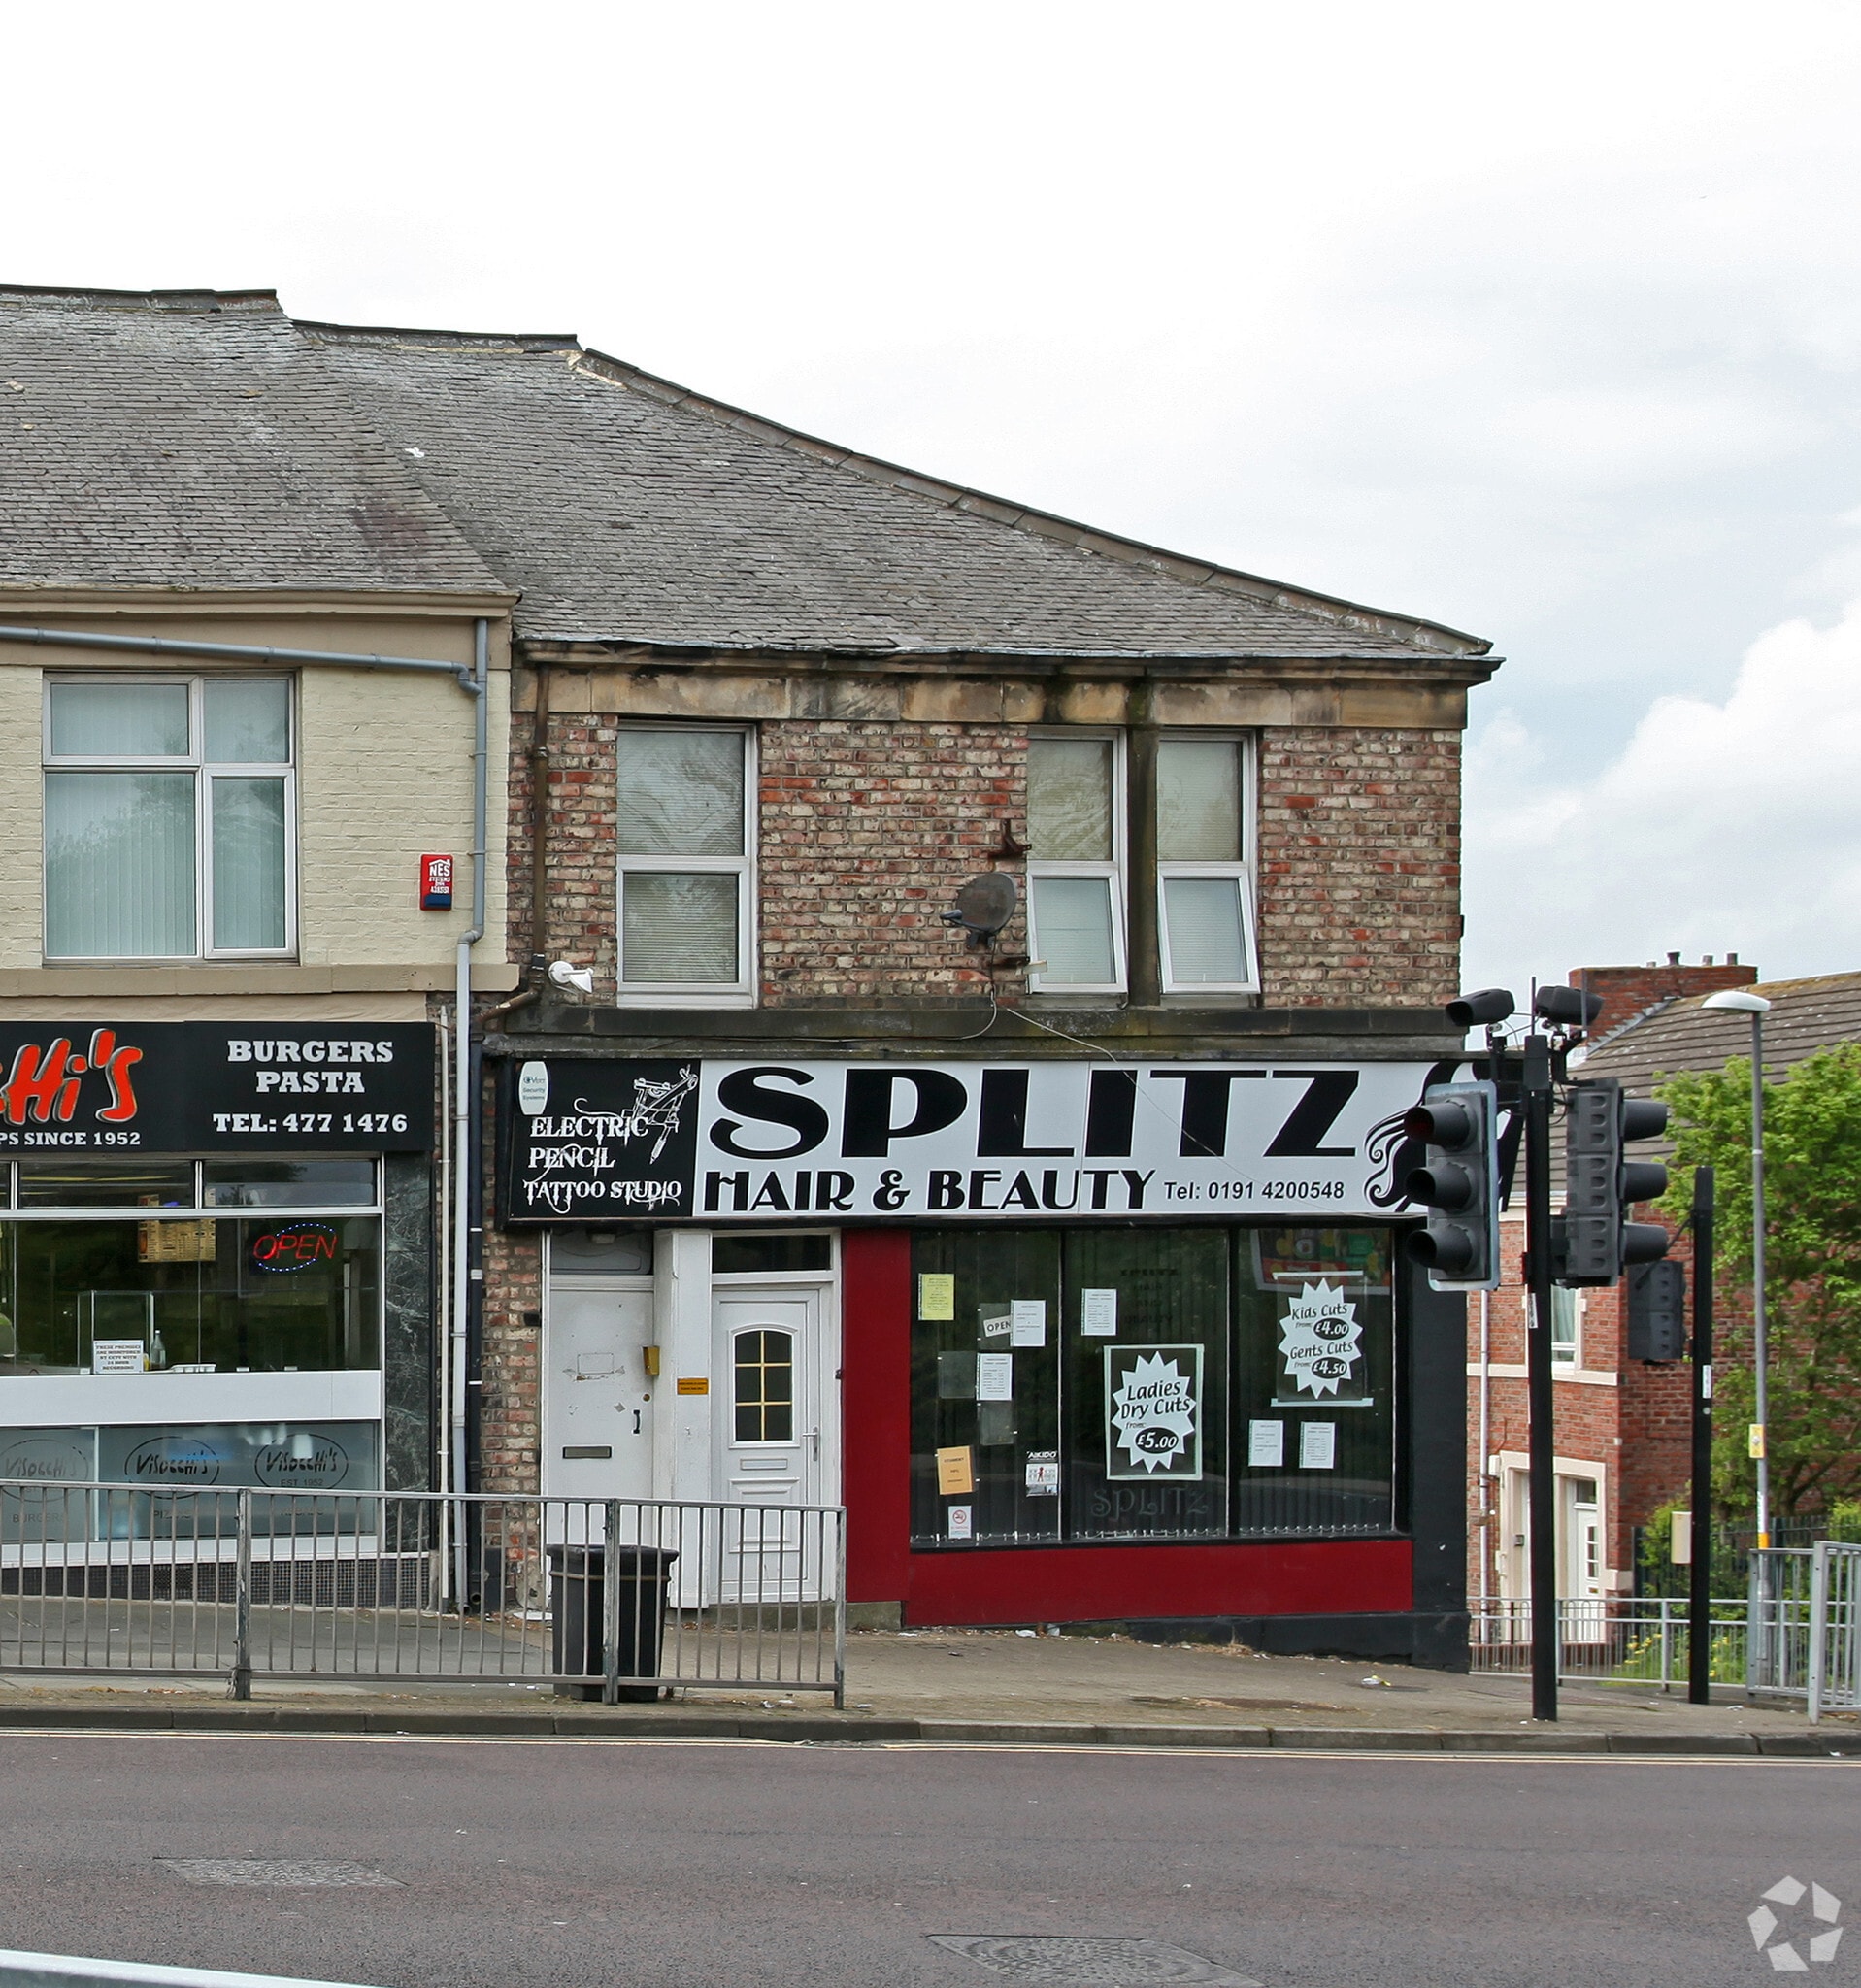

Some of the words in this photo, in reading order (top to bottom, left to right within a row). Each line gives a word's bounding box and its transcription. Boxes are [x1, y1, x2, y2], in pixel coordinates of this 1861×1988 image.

[429, 863, 450, 877] NES
[227, 1041, 393, 1063] BURGERS
[255, 1071, 365, 1093] PASTA
[709, 1066, 1359, 1159] SPLITZ
[213, 1114, 277, 1133] TEL:
[282, 1114, 332, 1132] 477
[343, 1114, 408, 1132] 1476
[530, 1115, 648, 1146] ELECTRIC
[24, 1132, 87, 1145] SINCE
[94, 1132, 141, 1145] 1952
[528, 1145, 615, 1177] PENCIL
[523, 1179, 606, 1211] TATTOO
[610, 1180, 682, 1210] STUDIO
[704, 1170, 855, 1211] HAIR
[872, 1169, 911, 1210] &
[927, 1169, 1155, 1211] BEAUTY
[1164, 1182, 1200, 1200] Tel:
[1208, 1181, 1254, 1199] 0191
[1262, 1181, 1345, 1199] 4200548
[253, 1234, 338, 1259] OPEN
[1291, 1307, 1317, 1320] Kids
[1321, 1303, 1348, 1316] Cuts
[1315, 1321, 1348, 1335] £4.00
[1290, 1343, 1323, 1359] Gents
[1327, 1341, 1353, 1355] Cuts
[1313, 1359, 1346, 1374] £4.50
[1127, 1380, 1181, 1401] Ladies
[1121, 1403, 1149, 1420] Dry
[1154, 1396, 1191, 1415] Cuts
[1137, 1431, 1179, 1449] £5.00
